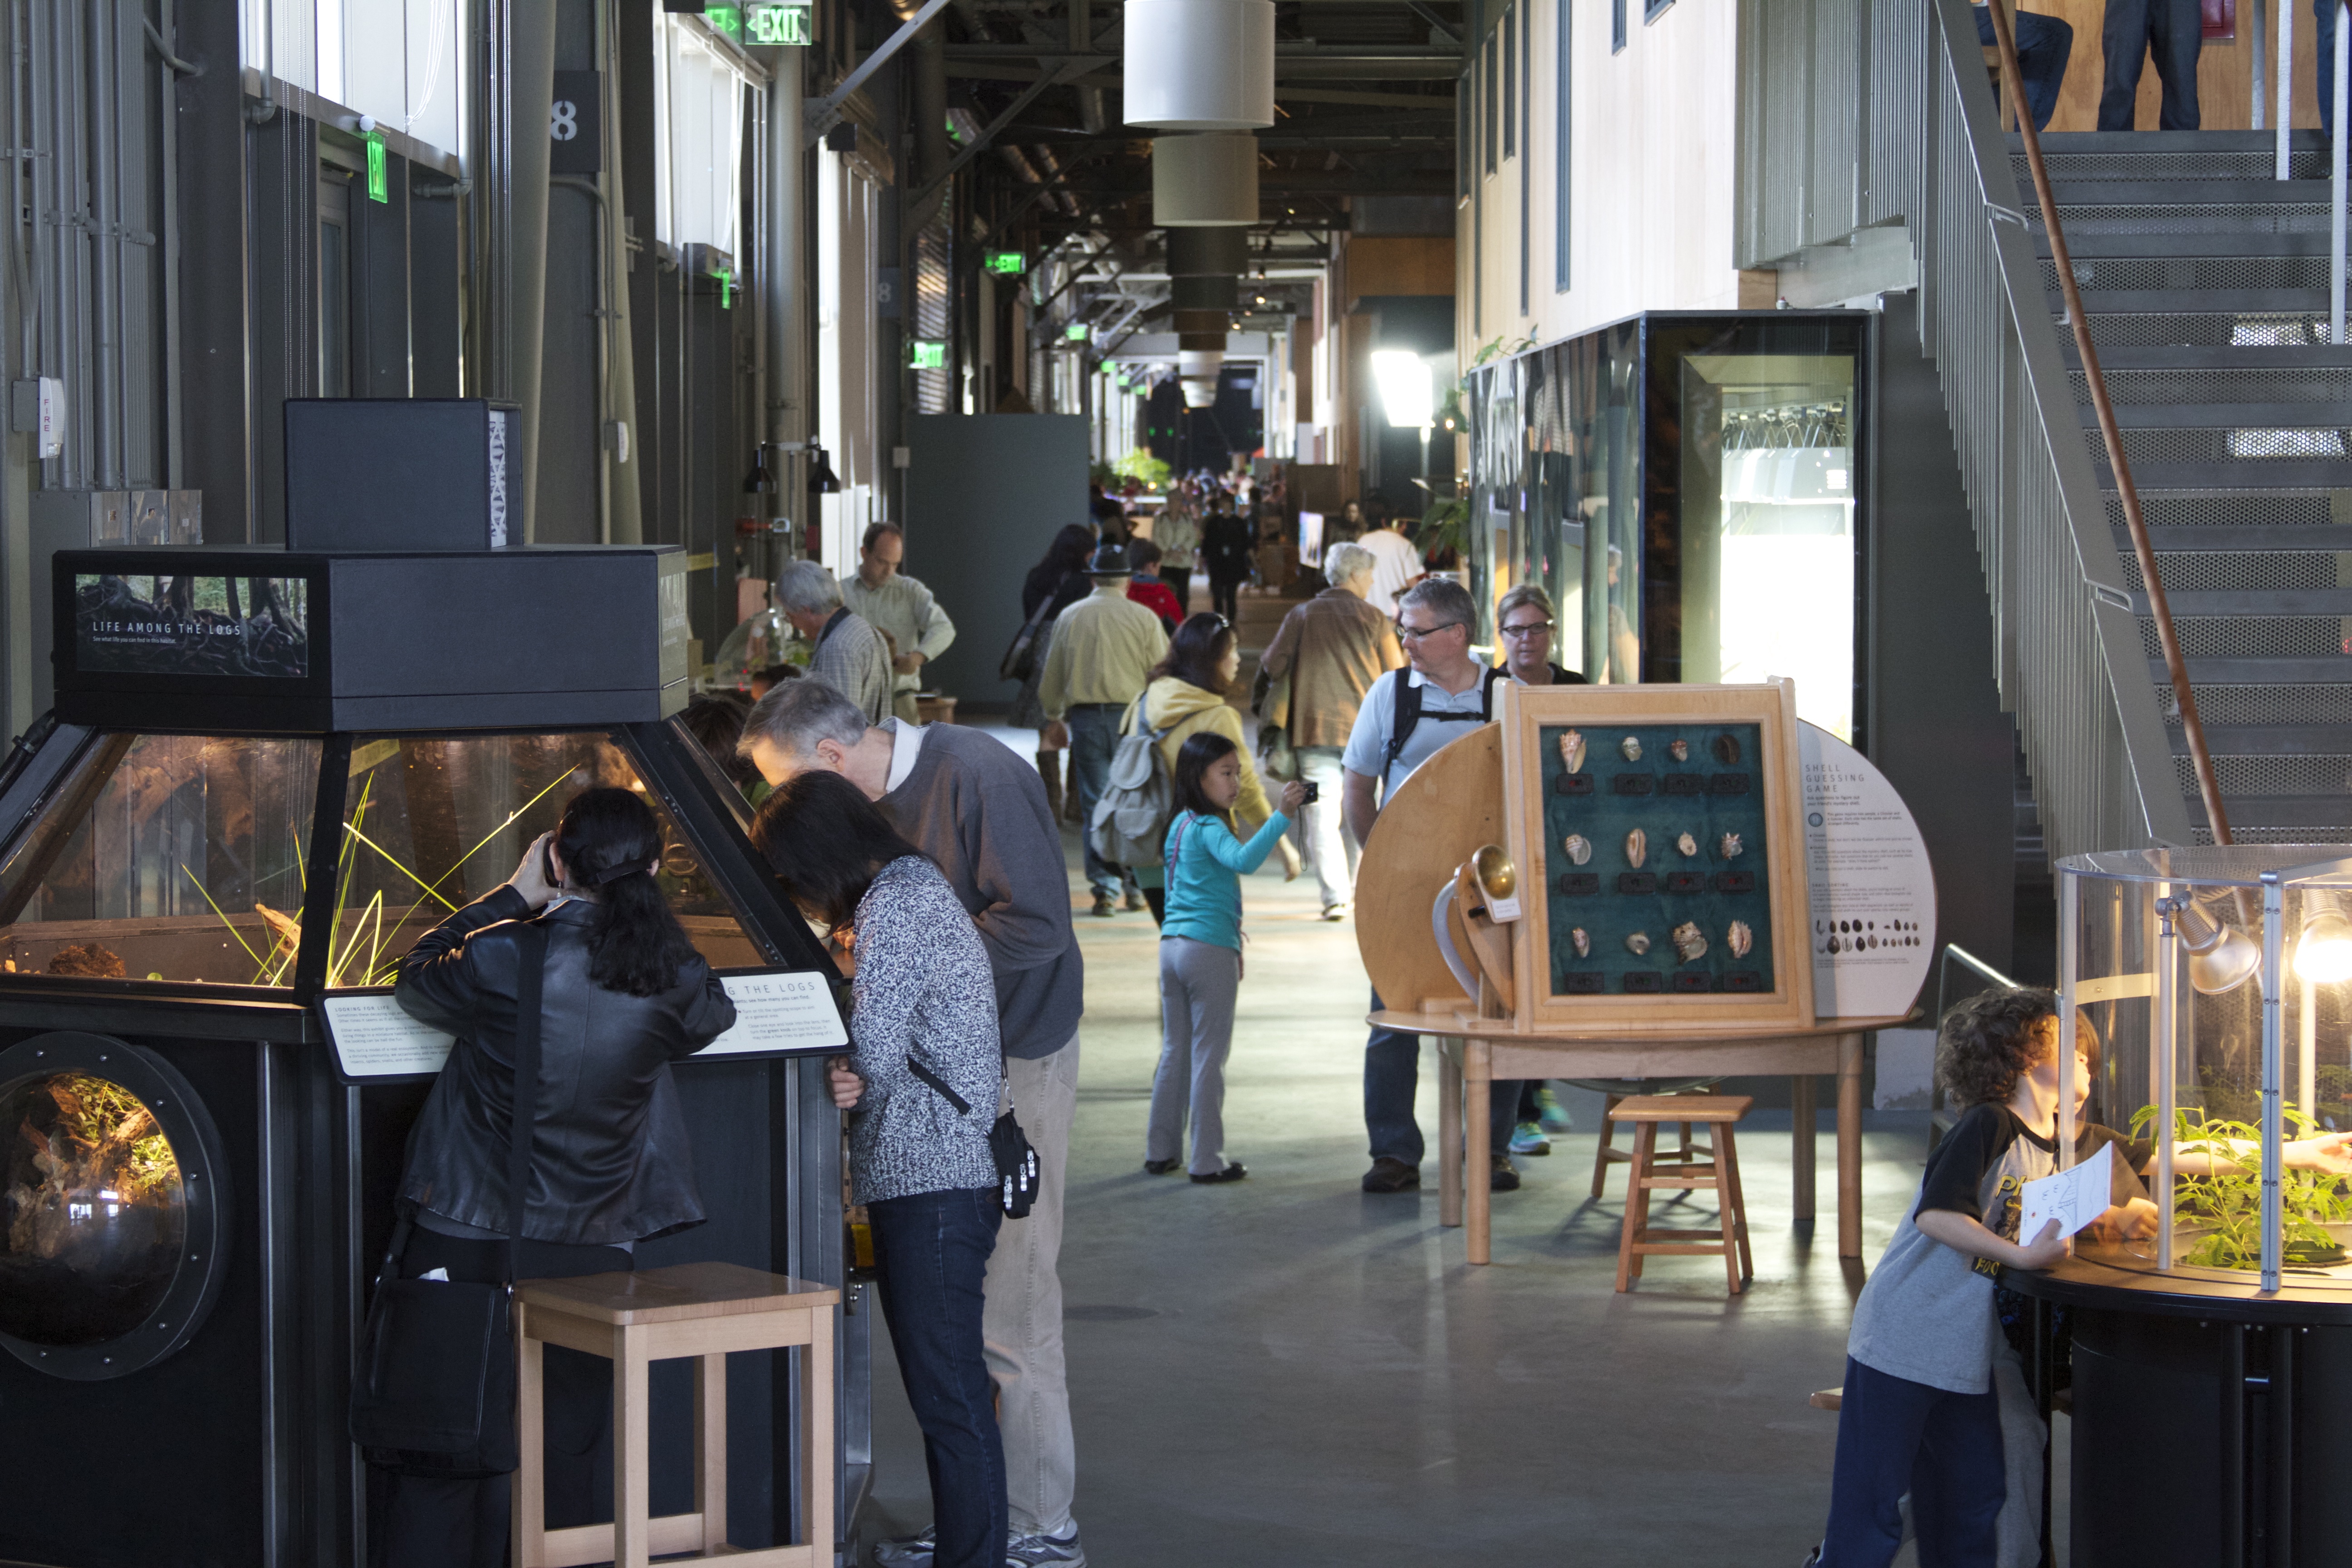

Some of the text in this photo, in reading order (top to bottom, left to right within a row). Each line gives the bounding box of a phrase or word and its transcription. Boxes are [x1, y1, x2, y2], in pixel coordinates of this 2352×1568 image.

[758, 9, 801, 41] EXIT
[914, 342, 944, 367] EXIT
[93, 622, 240, 635] LIFE AMONG THE LOGS
[1806, 774, 1865, 782] GUESSING
[744, 985, 771, 994] THE
[779, 982, 815, 992] LOGS
